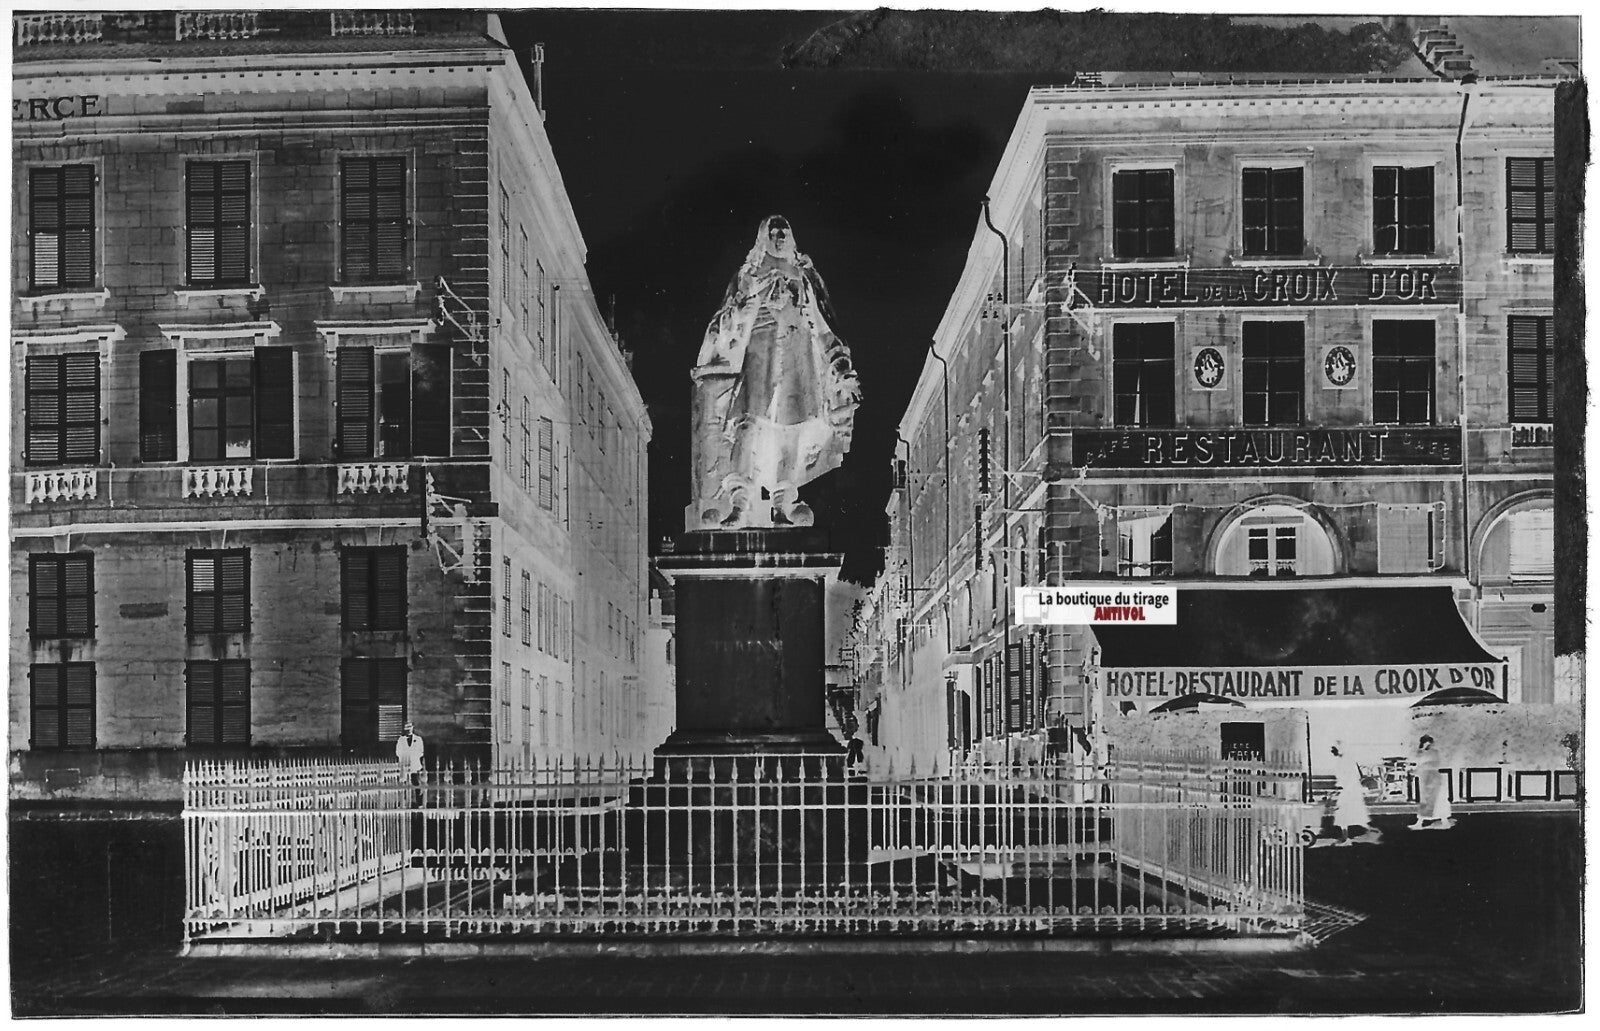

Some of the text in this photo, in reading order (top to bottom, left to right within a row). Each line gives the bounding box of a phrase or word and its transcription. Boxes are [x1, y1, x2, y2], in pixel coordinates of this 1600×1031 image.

[1096, 269, 1438, 304] HOTEL DE LA CROIX D'OR
[1141, 431, 1390, 464] RESTAURANT
[1106, 666, 1496, 697] HOTEL-RESTAURANT DE LA CROIX D'OR
